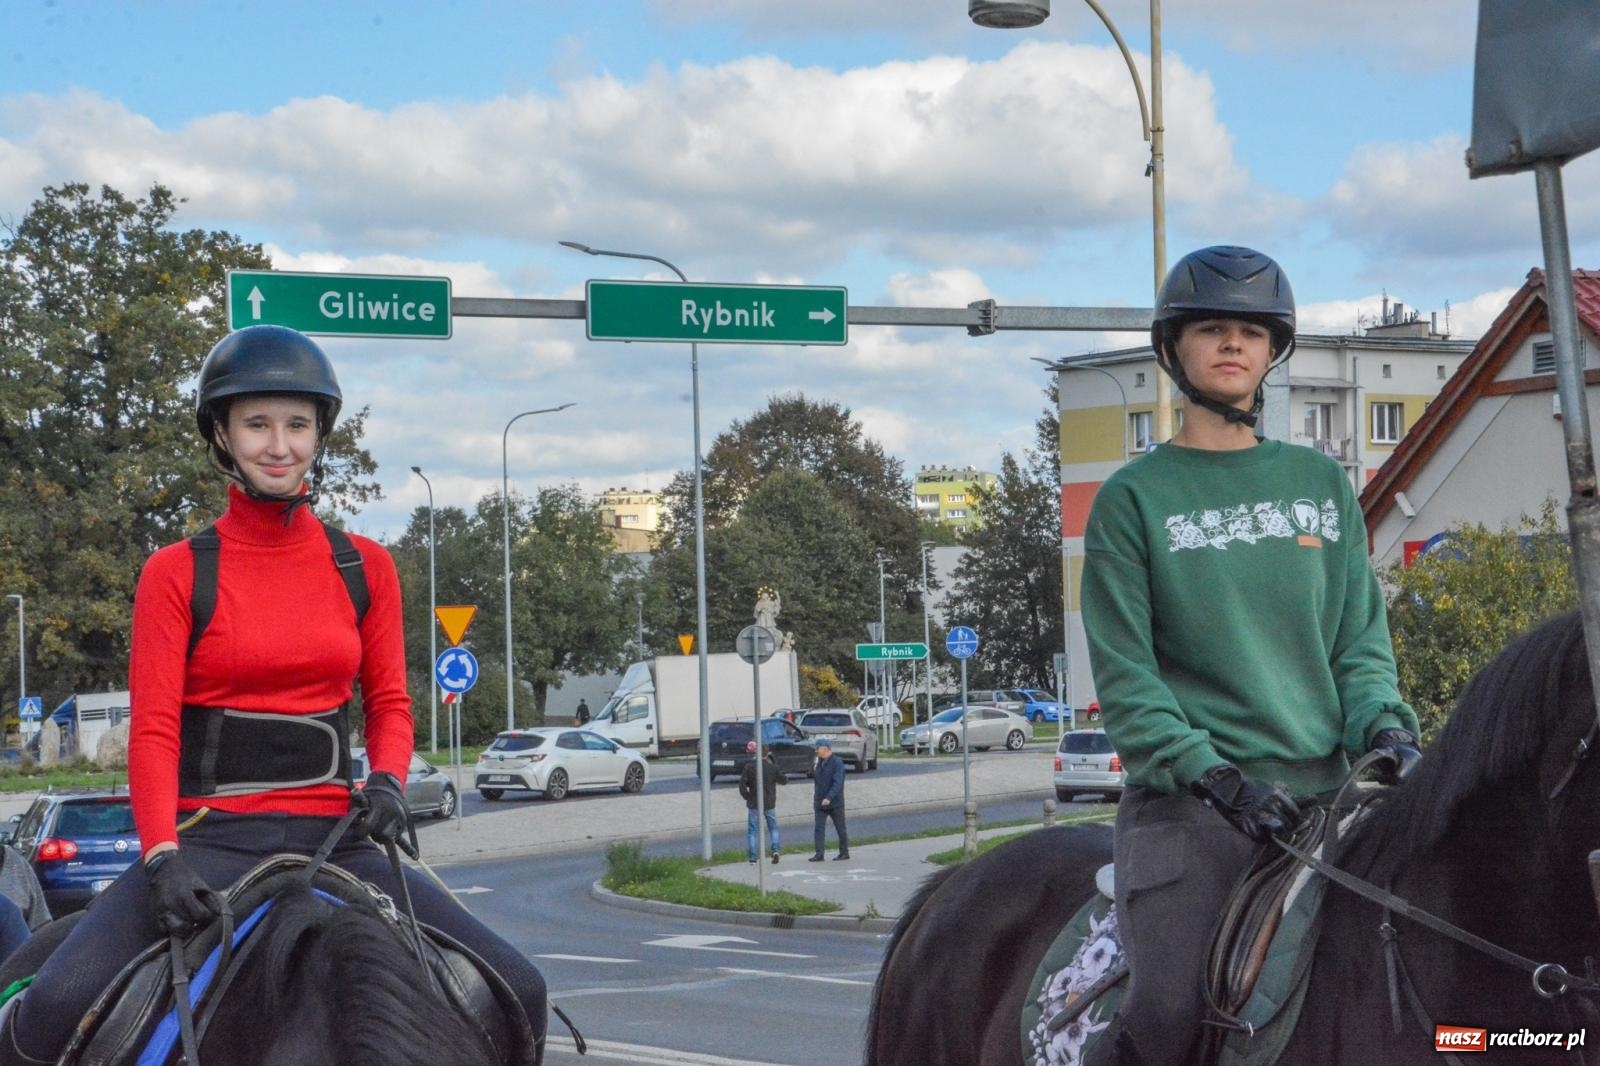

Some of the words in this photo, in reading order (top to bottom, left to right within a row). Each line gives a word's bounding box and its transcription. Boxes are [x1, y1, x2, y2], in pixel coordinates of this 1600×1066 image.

[319, 290, 436, 322] Gliwice
[681, 299, 776, 334] Rybnik
[881, 646, 913, 658] Rybnik
